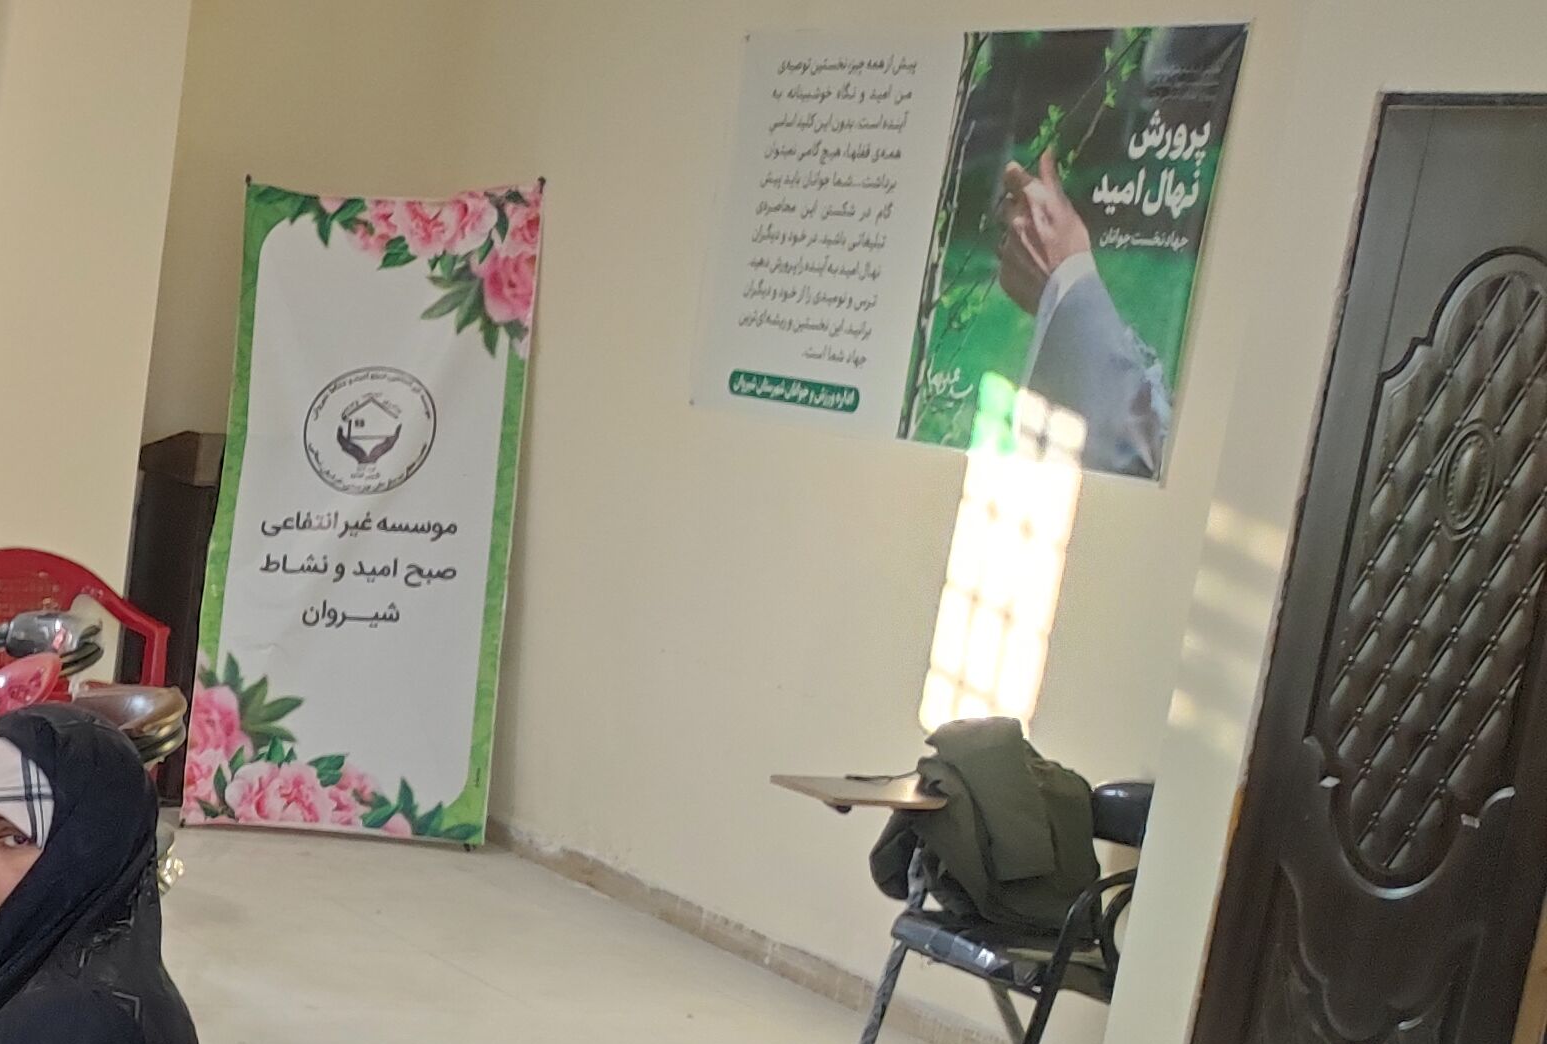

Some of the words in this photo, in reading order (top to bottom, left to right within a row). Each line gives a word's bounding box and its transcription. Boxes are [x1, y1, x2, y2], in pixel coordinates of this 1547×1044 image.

[1128, 109, 1211, 166] پرورش
[1092, 166, 1146, 215] امید
[1141, 166, 1201, 219] نهال
[260, 510, 339, 537] انتفاعی
[338, 510, 372, 539] غیر
[377, 516, 458, 542] موسسه
[259, 553, 328, 574] نشاط
[332, 561, 346, 583] و
[352, 557, 398, 583] امید
[404, 562, 458, 588] صبح
[301, 599, 400, 629] شیروان
